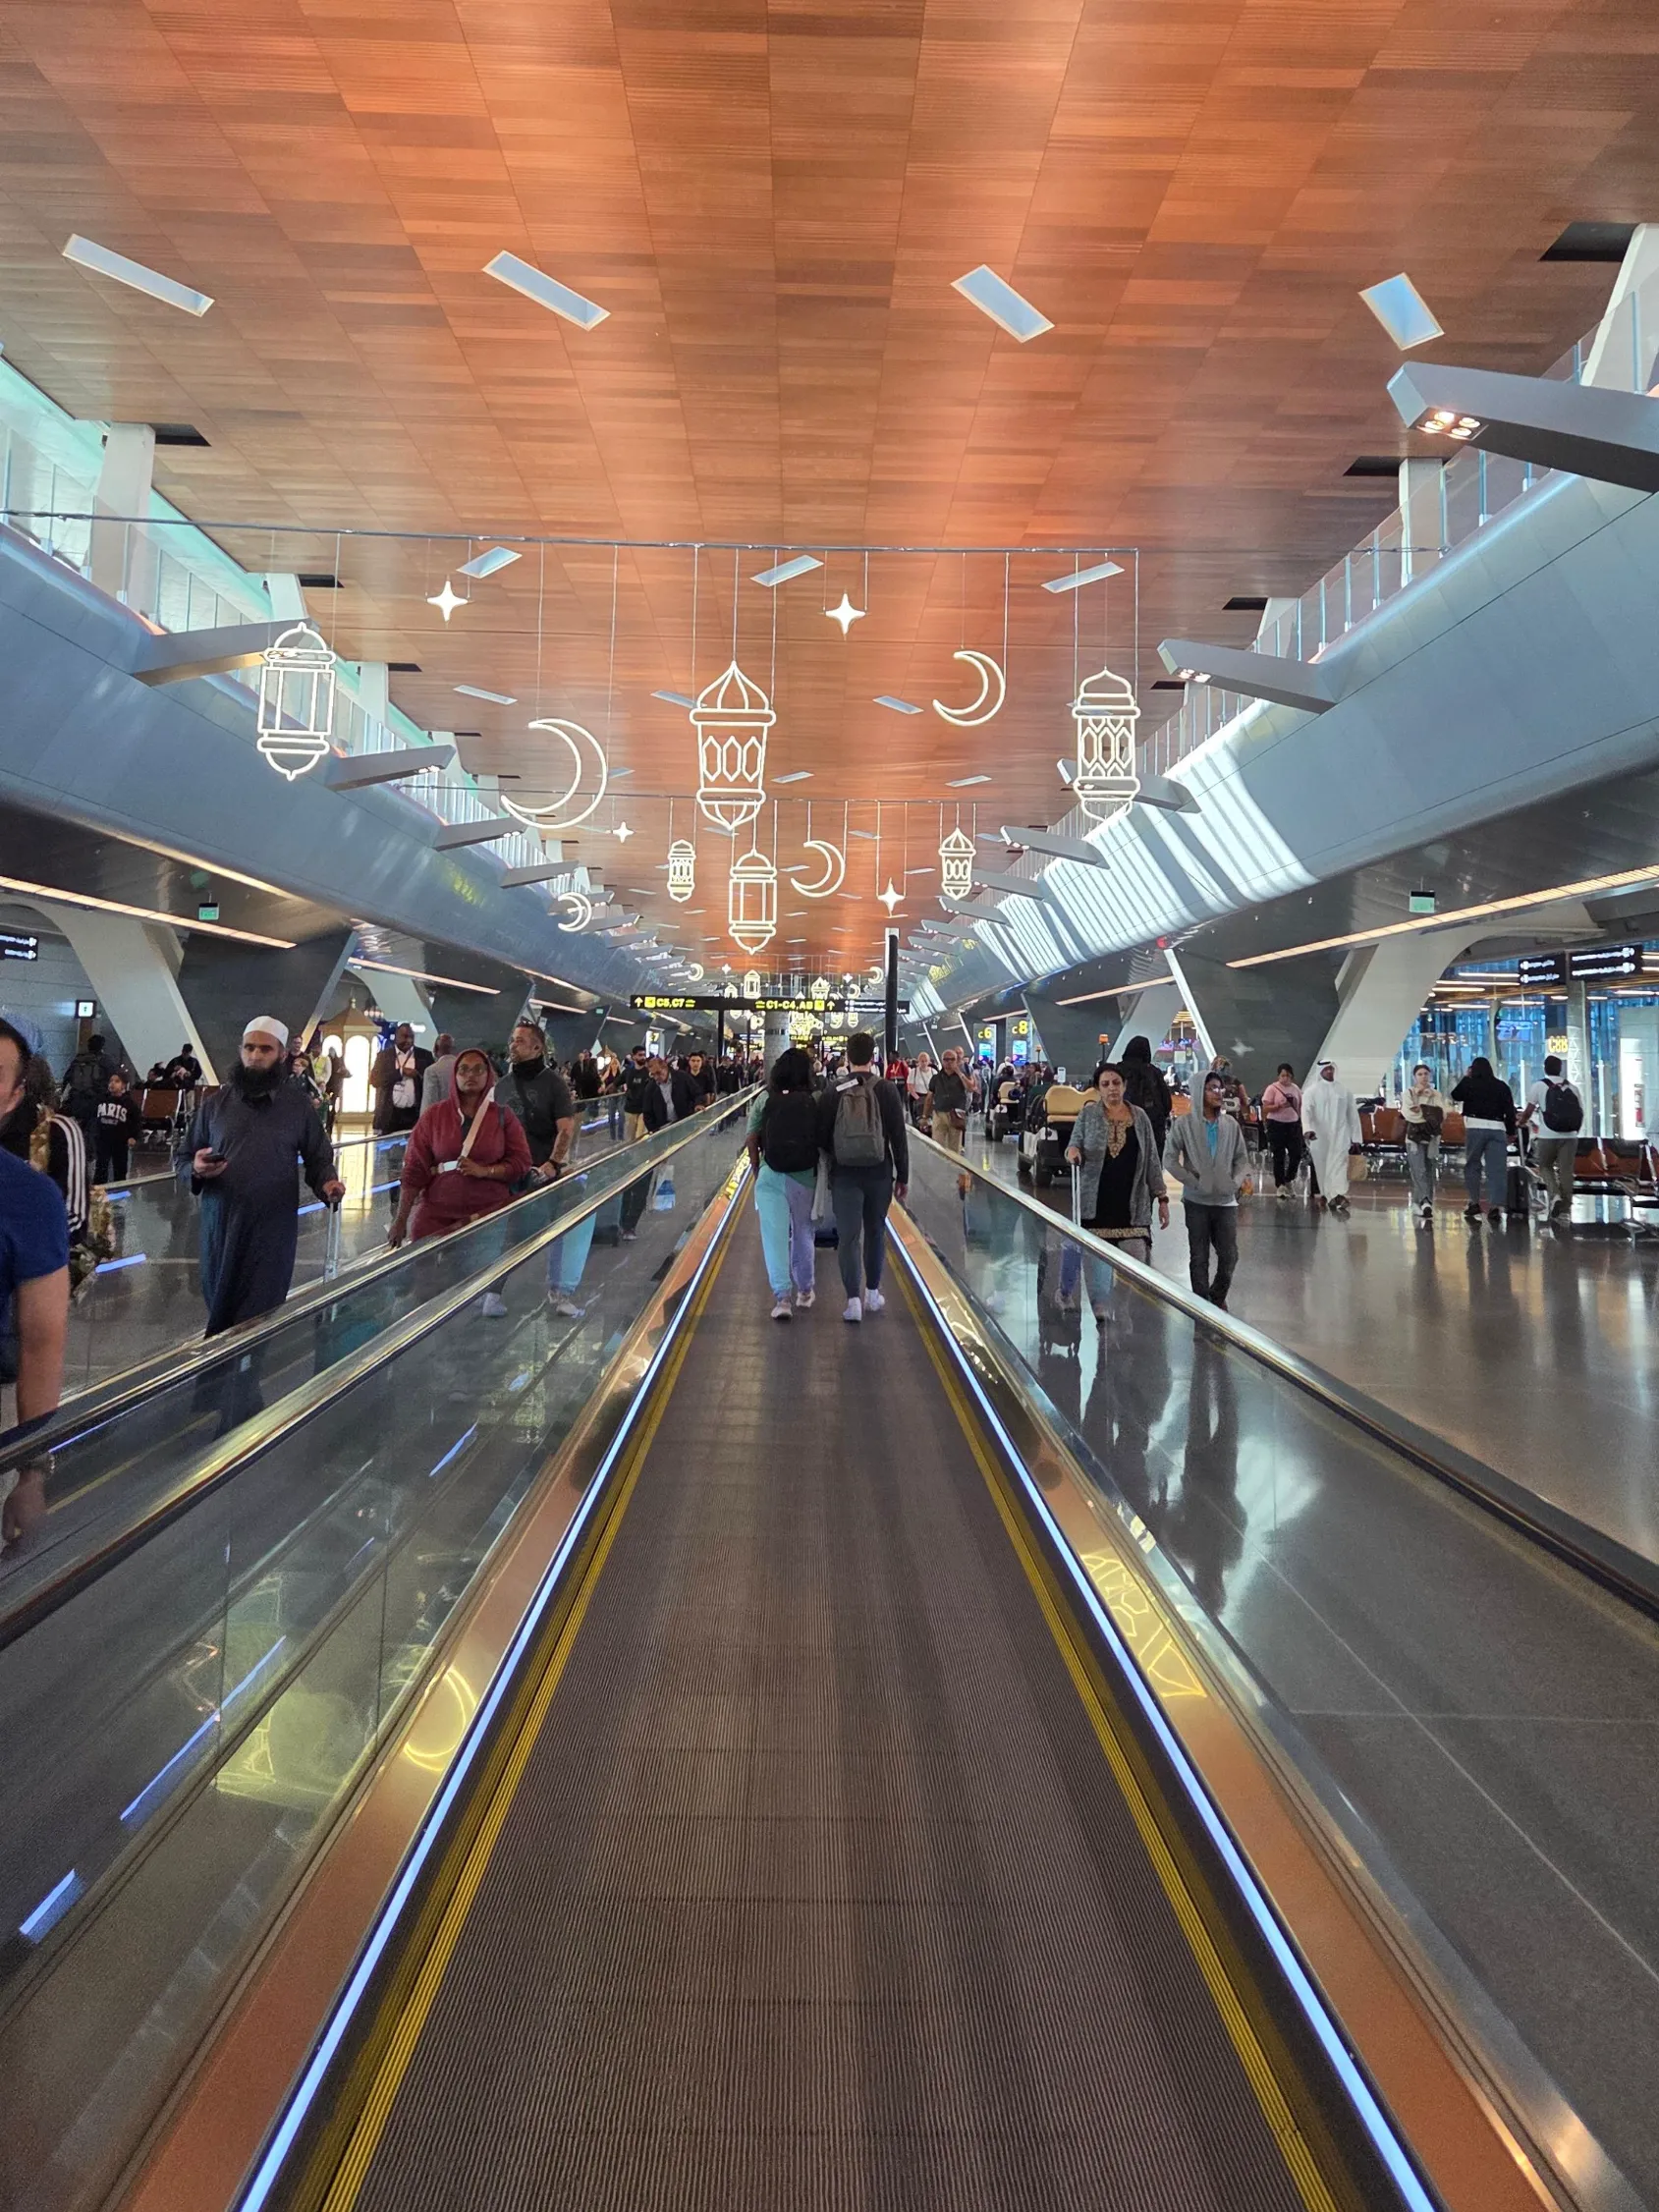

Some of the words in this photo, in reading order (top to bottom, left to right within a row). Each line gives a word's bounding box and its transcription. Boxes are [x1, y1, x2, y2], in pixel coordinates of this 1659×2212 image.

[977, 1026, 992, 1039] C6
[1012, 1020, 1028, 1034] C8
[96, 1102, 128, 1123] PARIS
